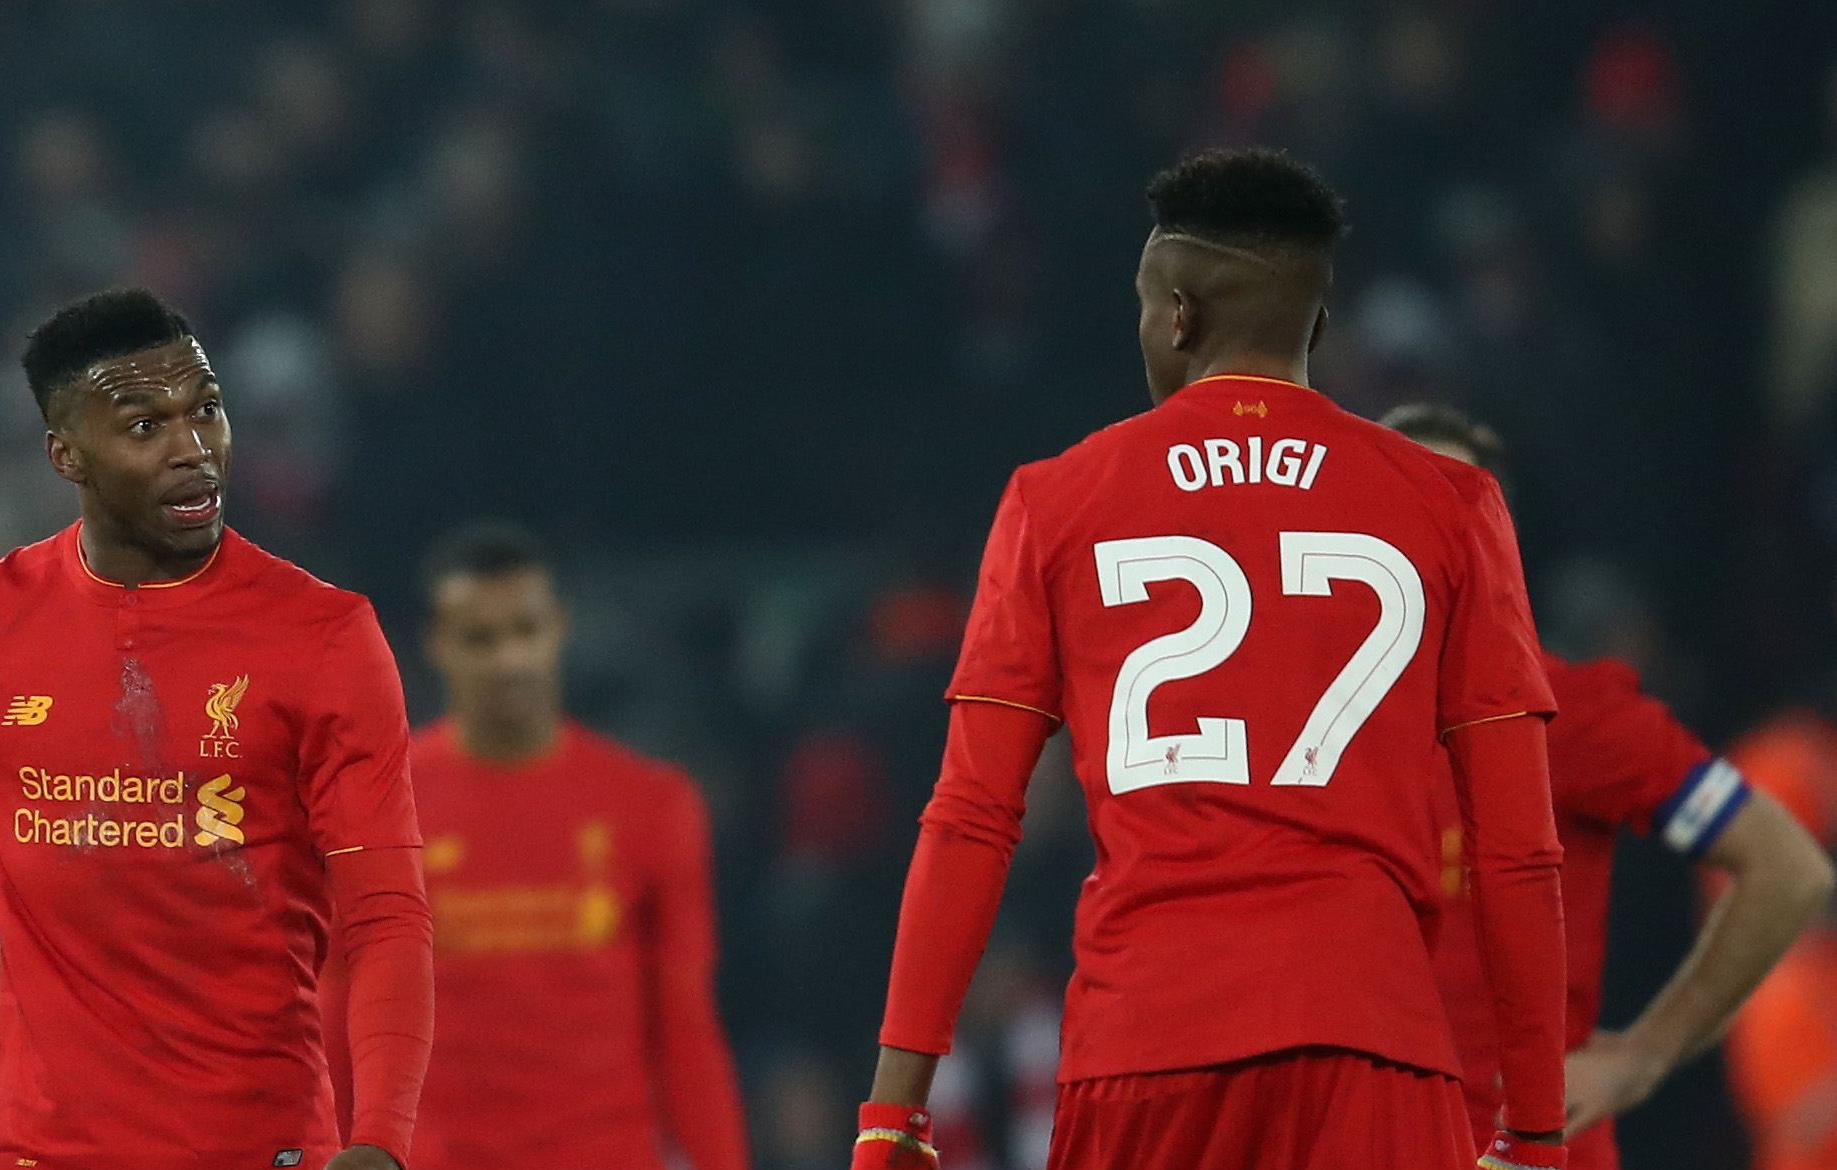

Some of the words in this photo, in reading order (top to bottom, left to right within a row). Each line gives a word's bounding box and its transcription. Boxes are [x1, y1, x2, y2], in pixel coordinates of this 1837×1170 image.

[1166, 436, 1327, 492] ORIGI
[1093, 530, 1426, 795] 27
[199, 740, 243, 759] L.F.C.
[18, 766, 185, 804] Standard
[14, 808, 185, 848] Chartered
